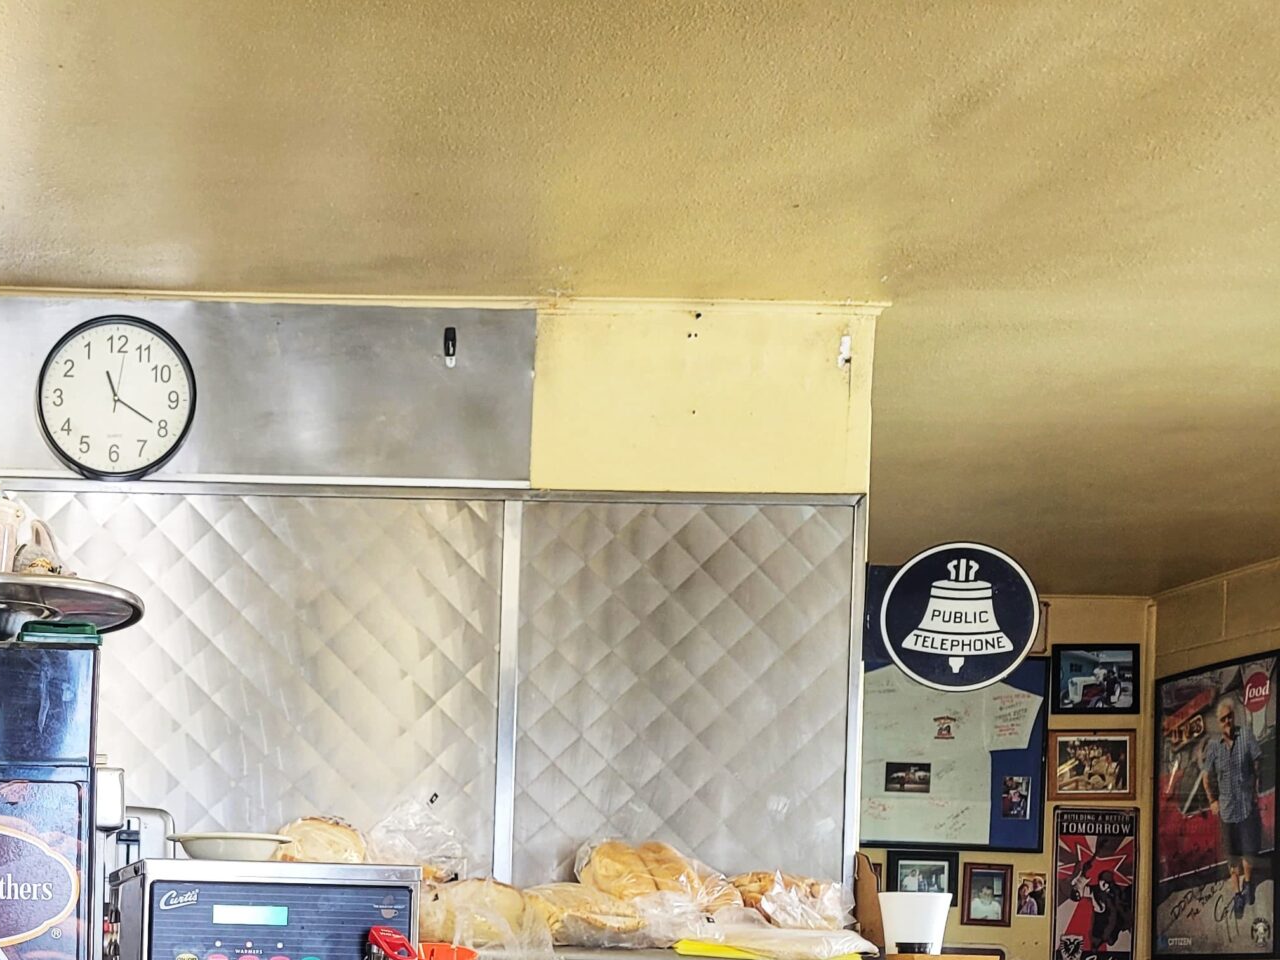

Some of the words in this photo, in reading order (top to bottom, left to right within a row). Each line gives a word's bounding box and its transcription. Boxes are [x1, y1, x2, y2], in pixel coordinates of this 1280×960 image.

[83, 341, 91, 360] 1
[106, 334, 129, 354] 12
[135, 344, 151, 363] 11
[63, 359, 75, 378] 2
[151, 364, 172, 383] 10
[52, 388, 63, 407] 3
[167, 390, 180, 410] 9
[60, 417, 72, 436] 4
[157, 419, 168, 438] 8
[79, 435, 90, 453] 5
[108, 444, 120, 463] 6
[136, 439, 148, 457] 7
[931, 609, 989, 624] PUBLIC
[913, 633, 1006, 652] TELEPHONE
[1243, 679, 1270, 706] food
[1062, 822, 1131, 834] TOMORROW
[159, 888, 199, 910] Curtis
